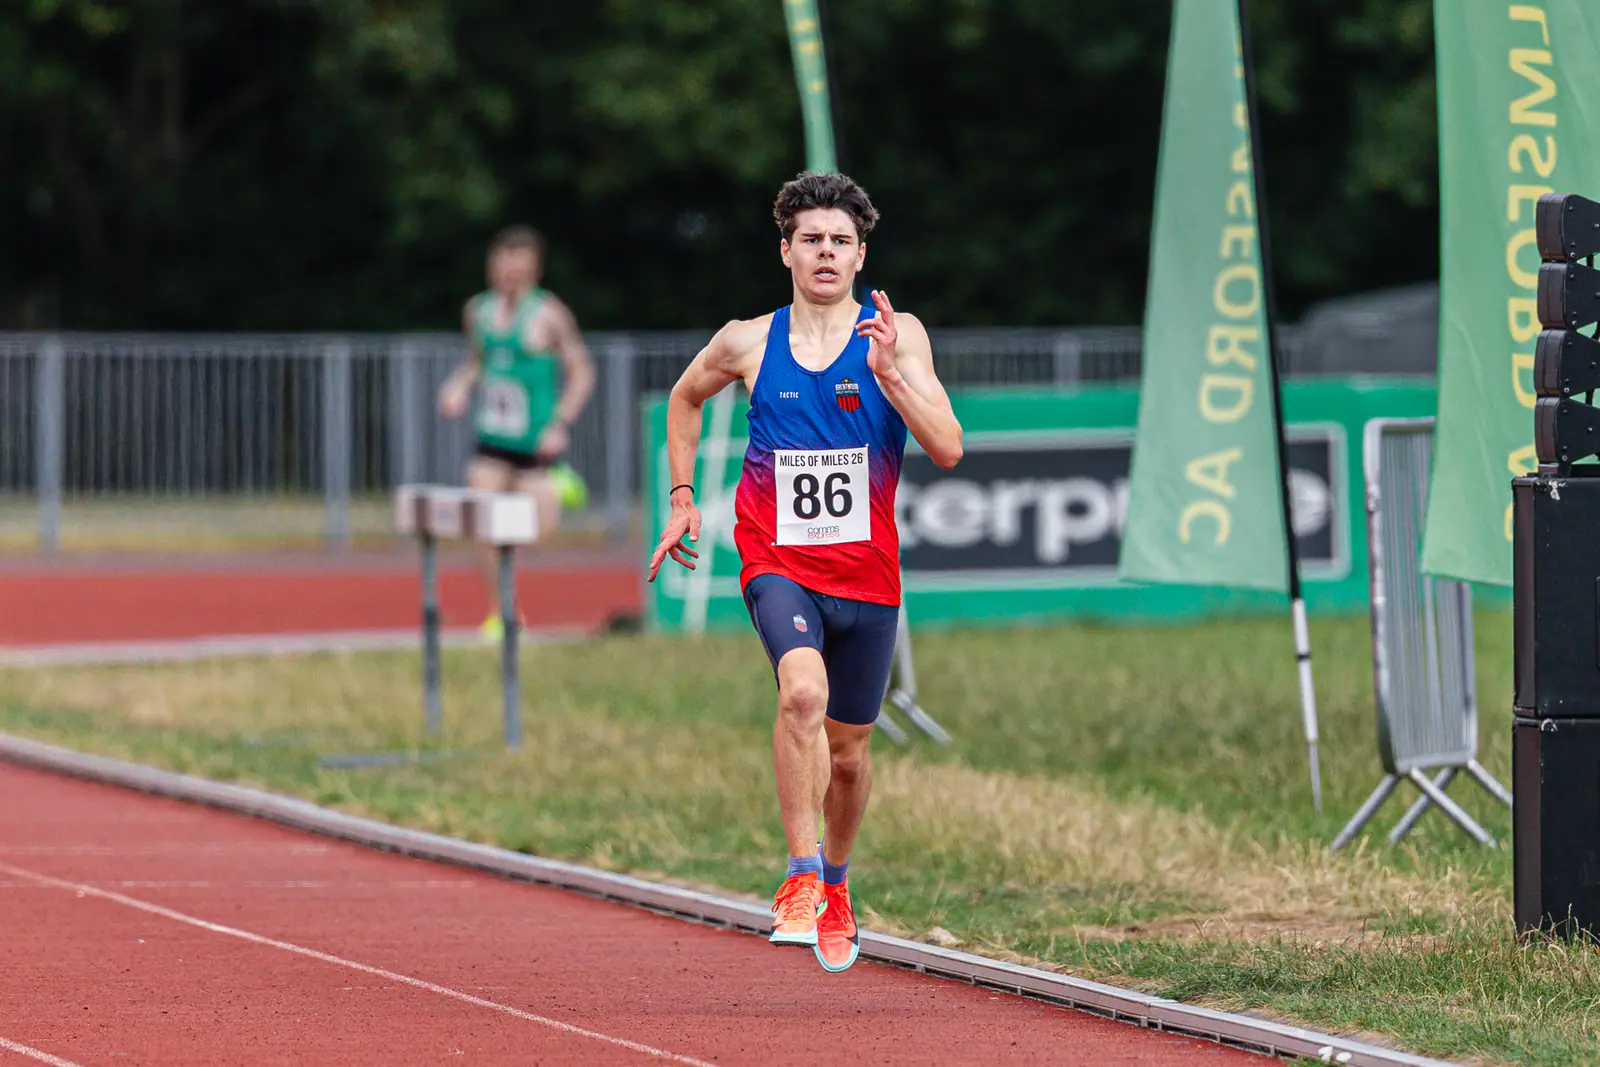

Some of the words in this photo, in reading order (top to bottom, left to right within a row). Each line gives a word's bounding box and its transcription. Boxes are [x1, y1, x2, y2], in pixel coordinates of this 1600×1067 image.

[779, 455, 806, 467] MILES
[808, 455, 819, 467] OF
[821, 453, 849, 466] MILES
[851, 452, 864, 465] 26
[793, 472, 853, 520] 86
[807, 525, 840, 534] comms
